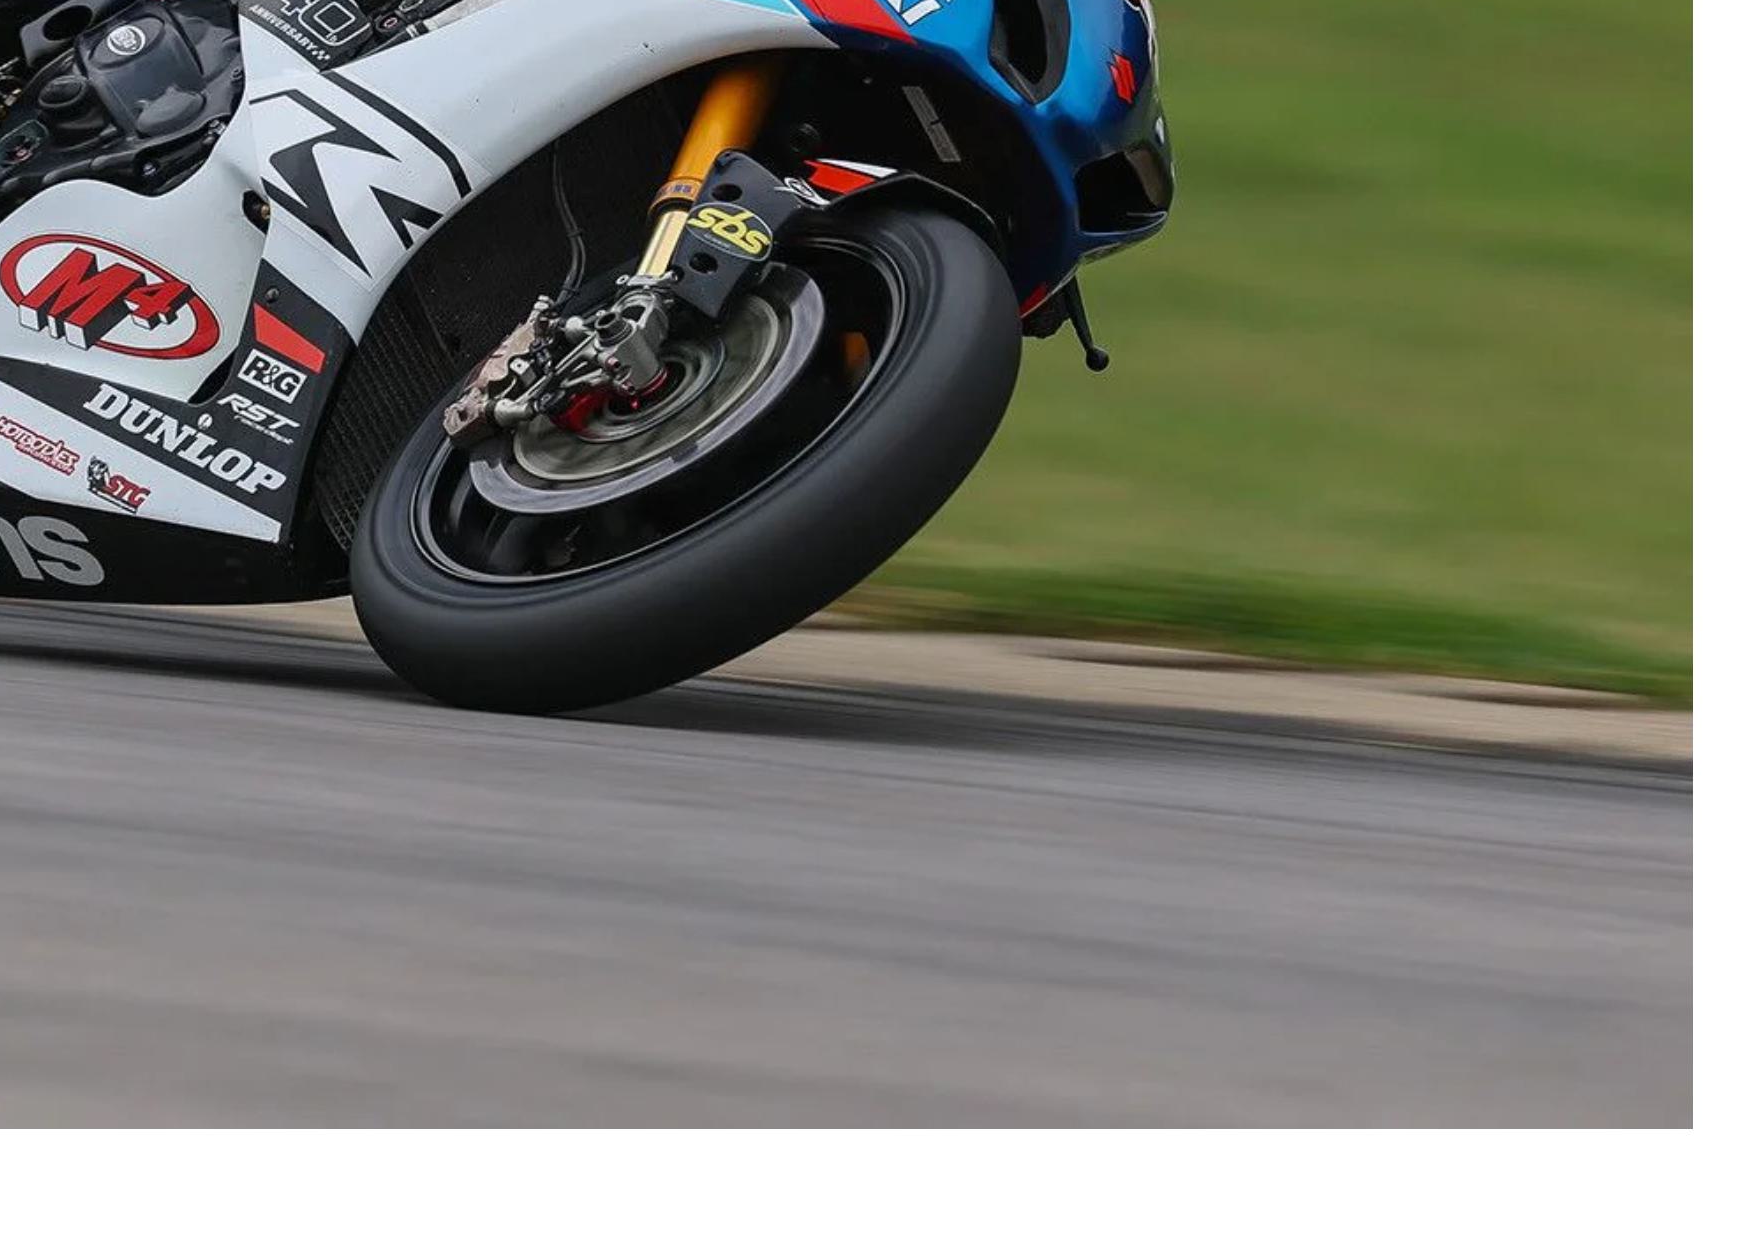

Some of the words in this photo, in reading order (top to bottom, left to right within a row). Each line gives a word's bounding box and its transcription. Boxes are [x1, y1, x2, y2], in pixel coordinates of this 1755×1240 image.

[249, 4, 317, 52] ANNIVERSARY
[687, 207, 772, 255] sbs
[19, 247, 196, 351] M4
[243, 355, 301, 398] R&G
[217, 392, 301, 430] RST
[82, 382, 288, 495] DUNLOP
[104, 474, 151, 507] STG
